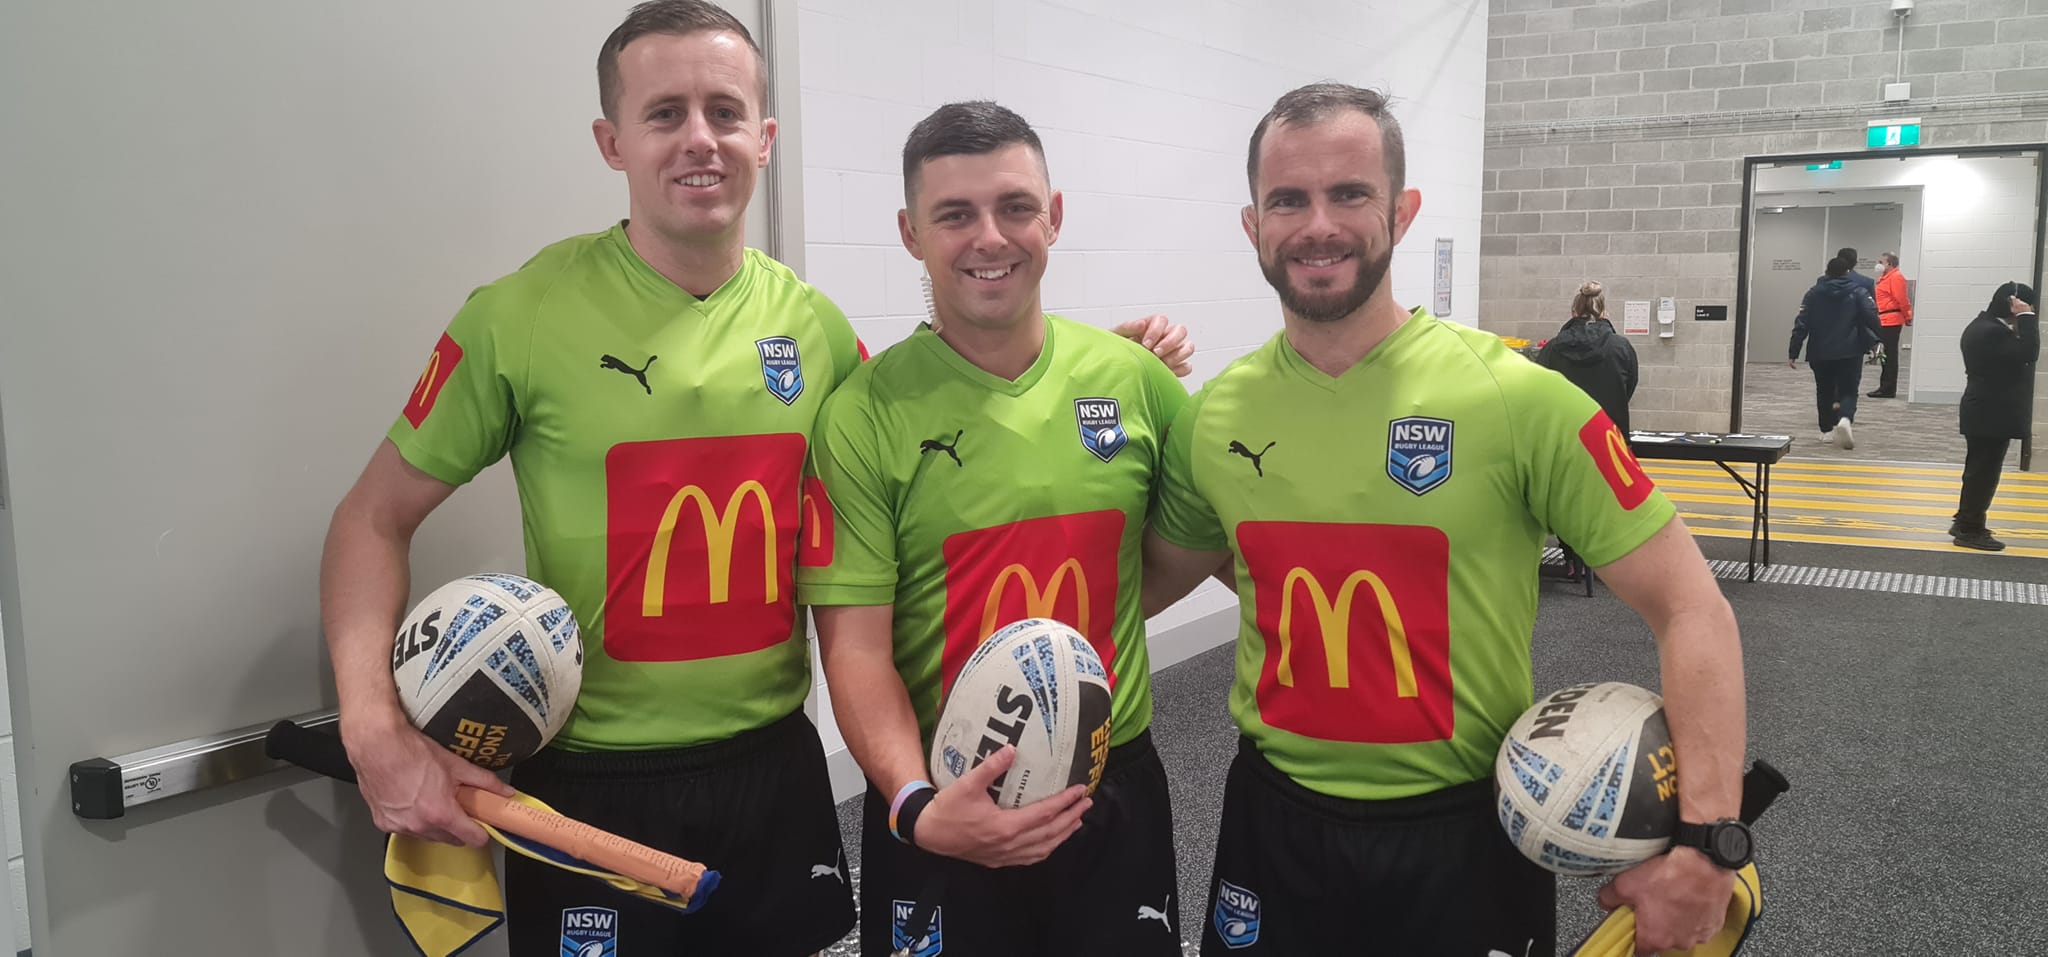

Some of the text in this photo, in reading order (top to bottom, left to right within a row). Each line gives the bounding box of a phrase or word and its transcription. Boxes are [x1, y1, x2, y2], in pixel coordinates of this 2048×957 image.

[762, 343, 795, 358] NSW
[1079, 404, 1115, 418] NSW
[1395, 424, 1447, 442] NSW
[1394, 442, 1445, 451] RUGBY LEAGUE
[1529, 685, 1597, 740] DEN
[474, 725, 508, 764] KNOC
[970, 684, 1033, 805] STE
[1018, 769, 1031, 791] ELITE
[1221, 884, 1258, 912] NSW
[567, 912, 613, 929] NSW
[588, 930, 612, 938] LEAGUE
